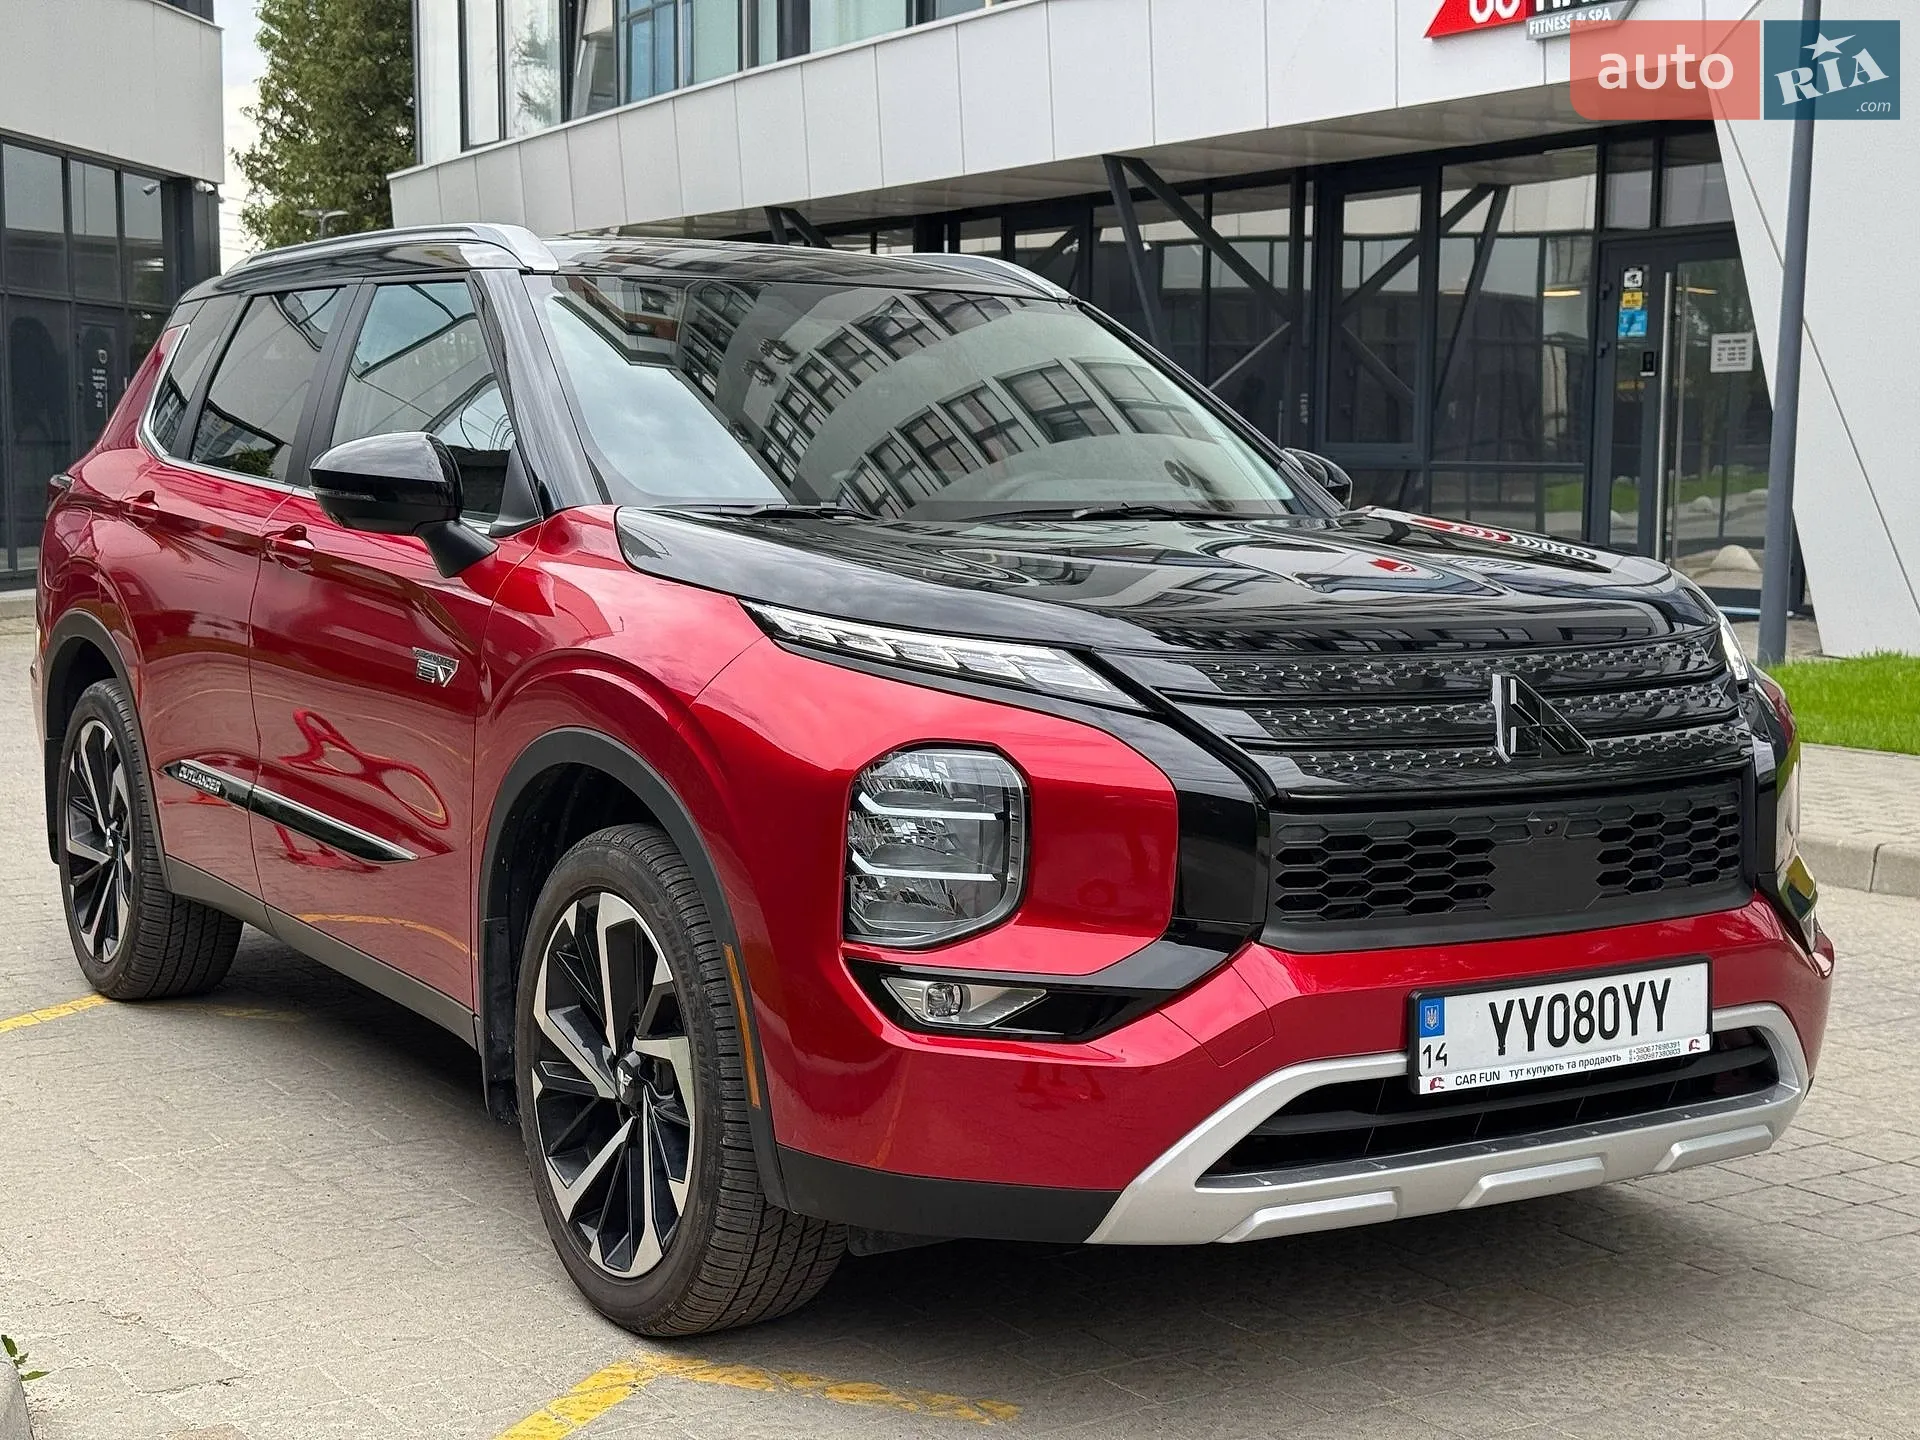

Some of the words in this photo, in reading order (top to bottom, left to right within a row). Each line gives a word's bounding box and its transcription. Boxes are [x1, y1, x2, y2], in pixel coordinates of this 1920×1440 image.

[1529, 14, 1572, 36] FITNESS
[1588, 9, 1611, 24] SPA
[179, 766, 222, 794] OUTLANDER
[1489, 978, 1671, 1055] YY080YY
[1422, 1042, 1448, 1069] 14
[1509, 1068, 1525, 1079] тут
[1526, 1061, 1564, 1077] купують
[1567, 1060, 1577, 1070] та
[1578, 1053, 1622, 1069] продають
[1455, 1072, 1477, 1086] CAR
[1479, 1070, 1501, 1084] FUN
